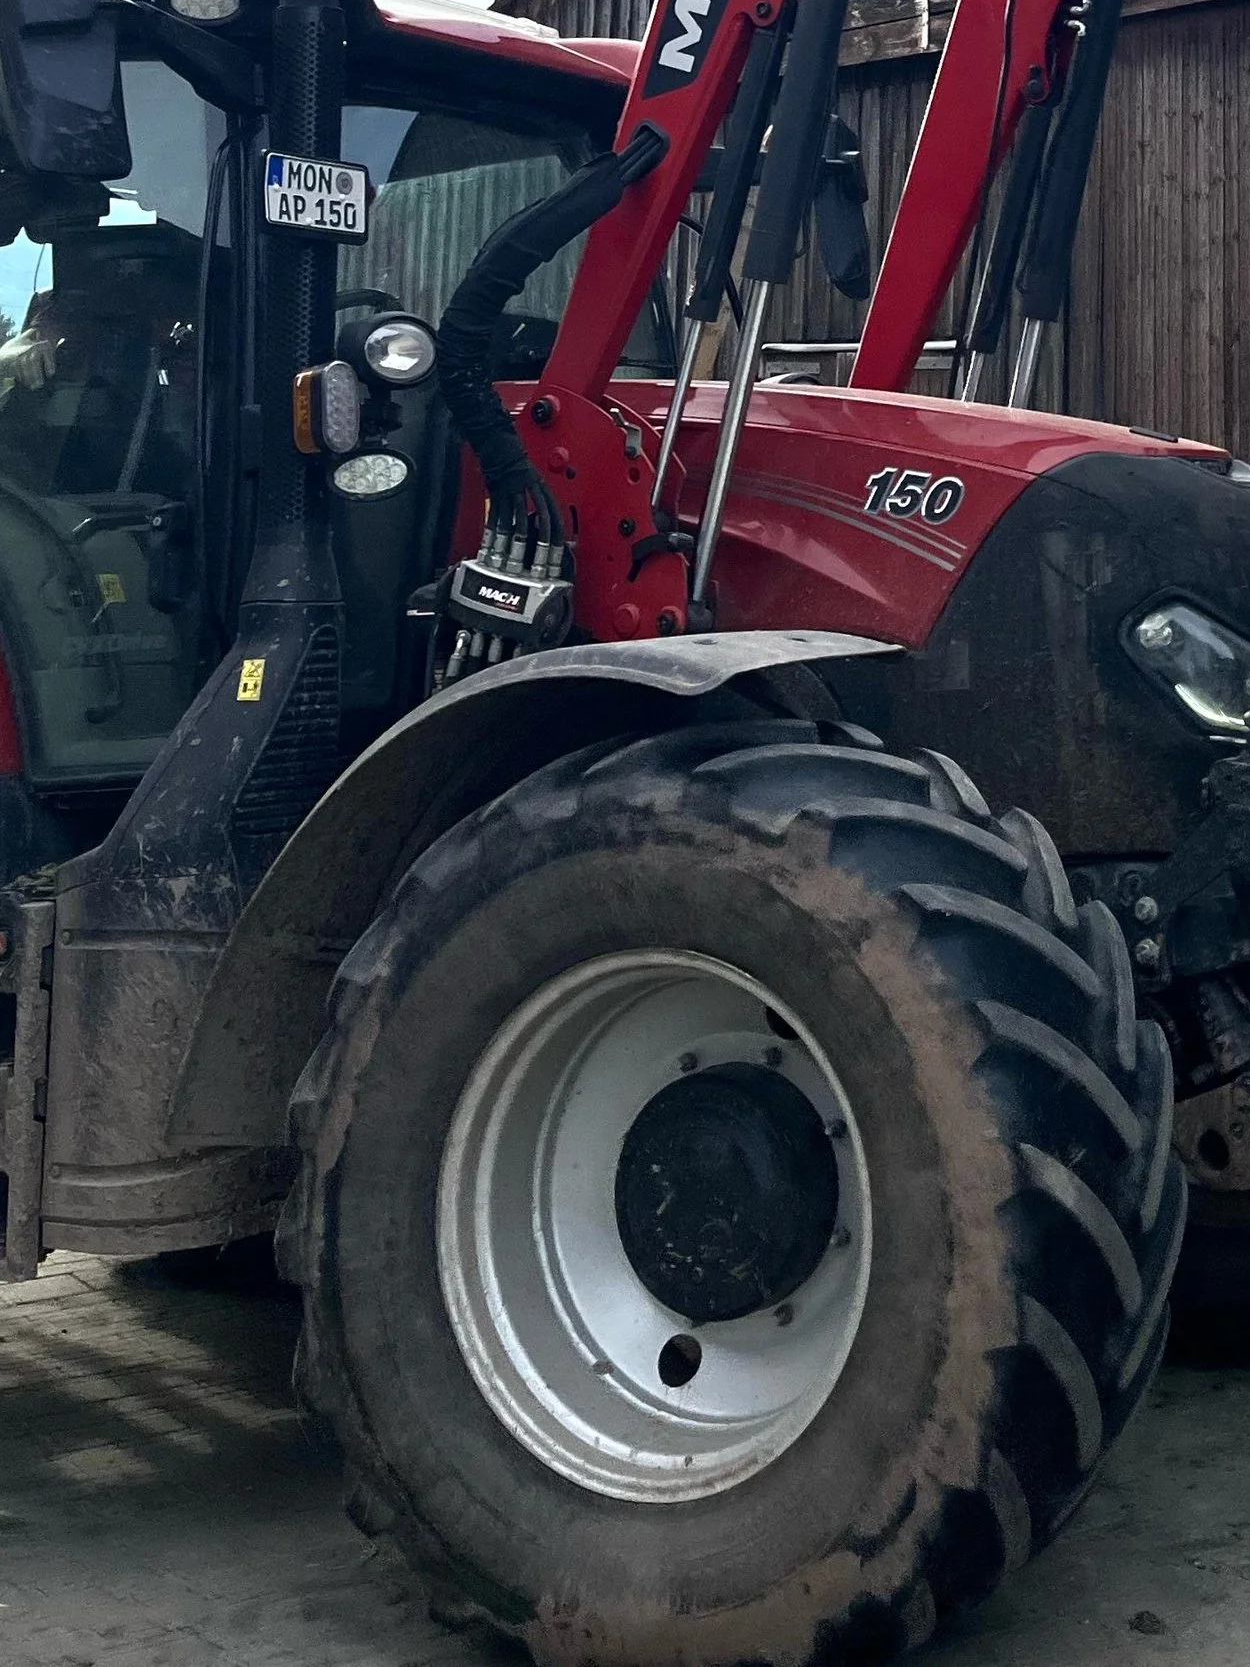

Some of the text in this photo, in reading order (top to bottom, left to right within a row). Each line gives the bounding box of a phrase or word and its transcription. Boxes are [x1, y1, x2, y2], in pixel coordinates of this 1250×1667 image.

[287, 161, 333, 195] MON
[278, 193, 357, 230] AP 150
[863, 466, 965, 525] 150
[478, 585, 521, 606] MACH
